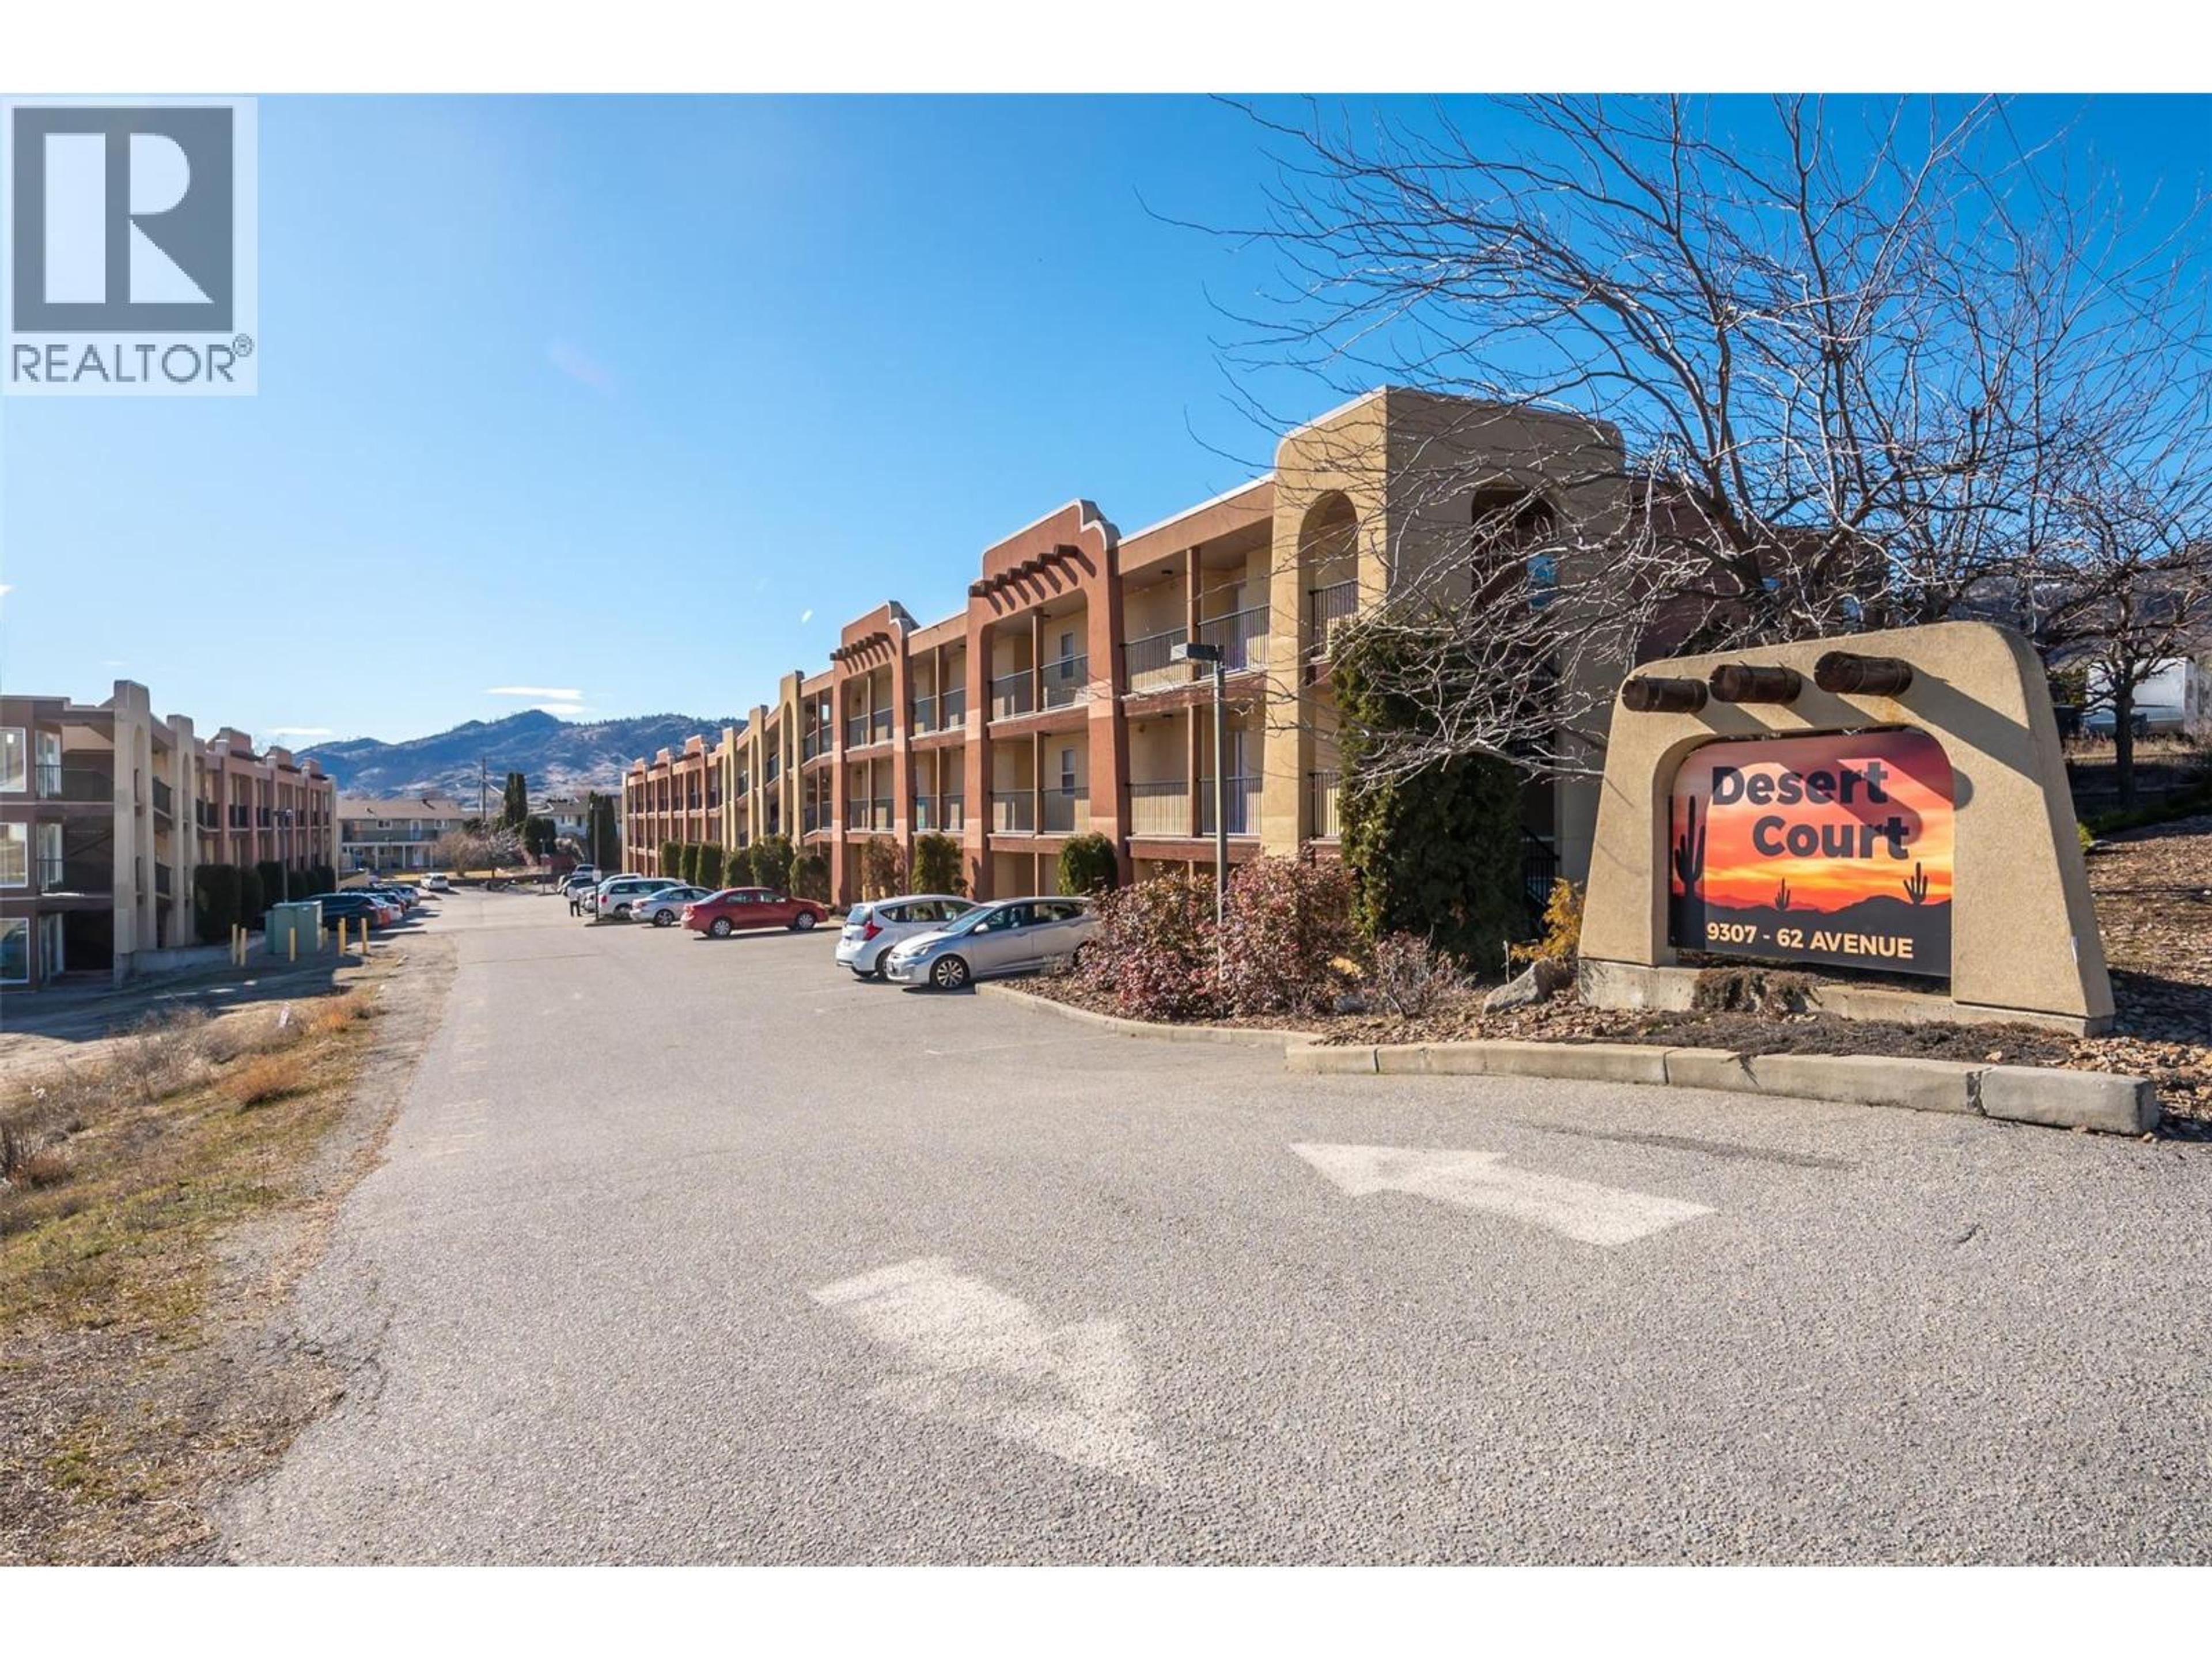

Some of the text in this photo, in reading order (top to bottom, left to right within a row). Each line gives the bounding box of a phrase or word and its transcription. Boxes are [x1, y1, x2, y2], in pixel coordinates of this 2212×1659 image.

[1712, 762, 1888, 805] Desert
[1752, 816, 1909, 859] Court
[1706, 922, 1757, 944] 9307
[1776, 929, 1804, 948] 62
[1809, 931, 1913, 959] AVENUE
